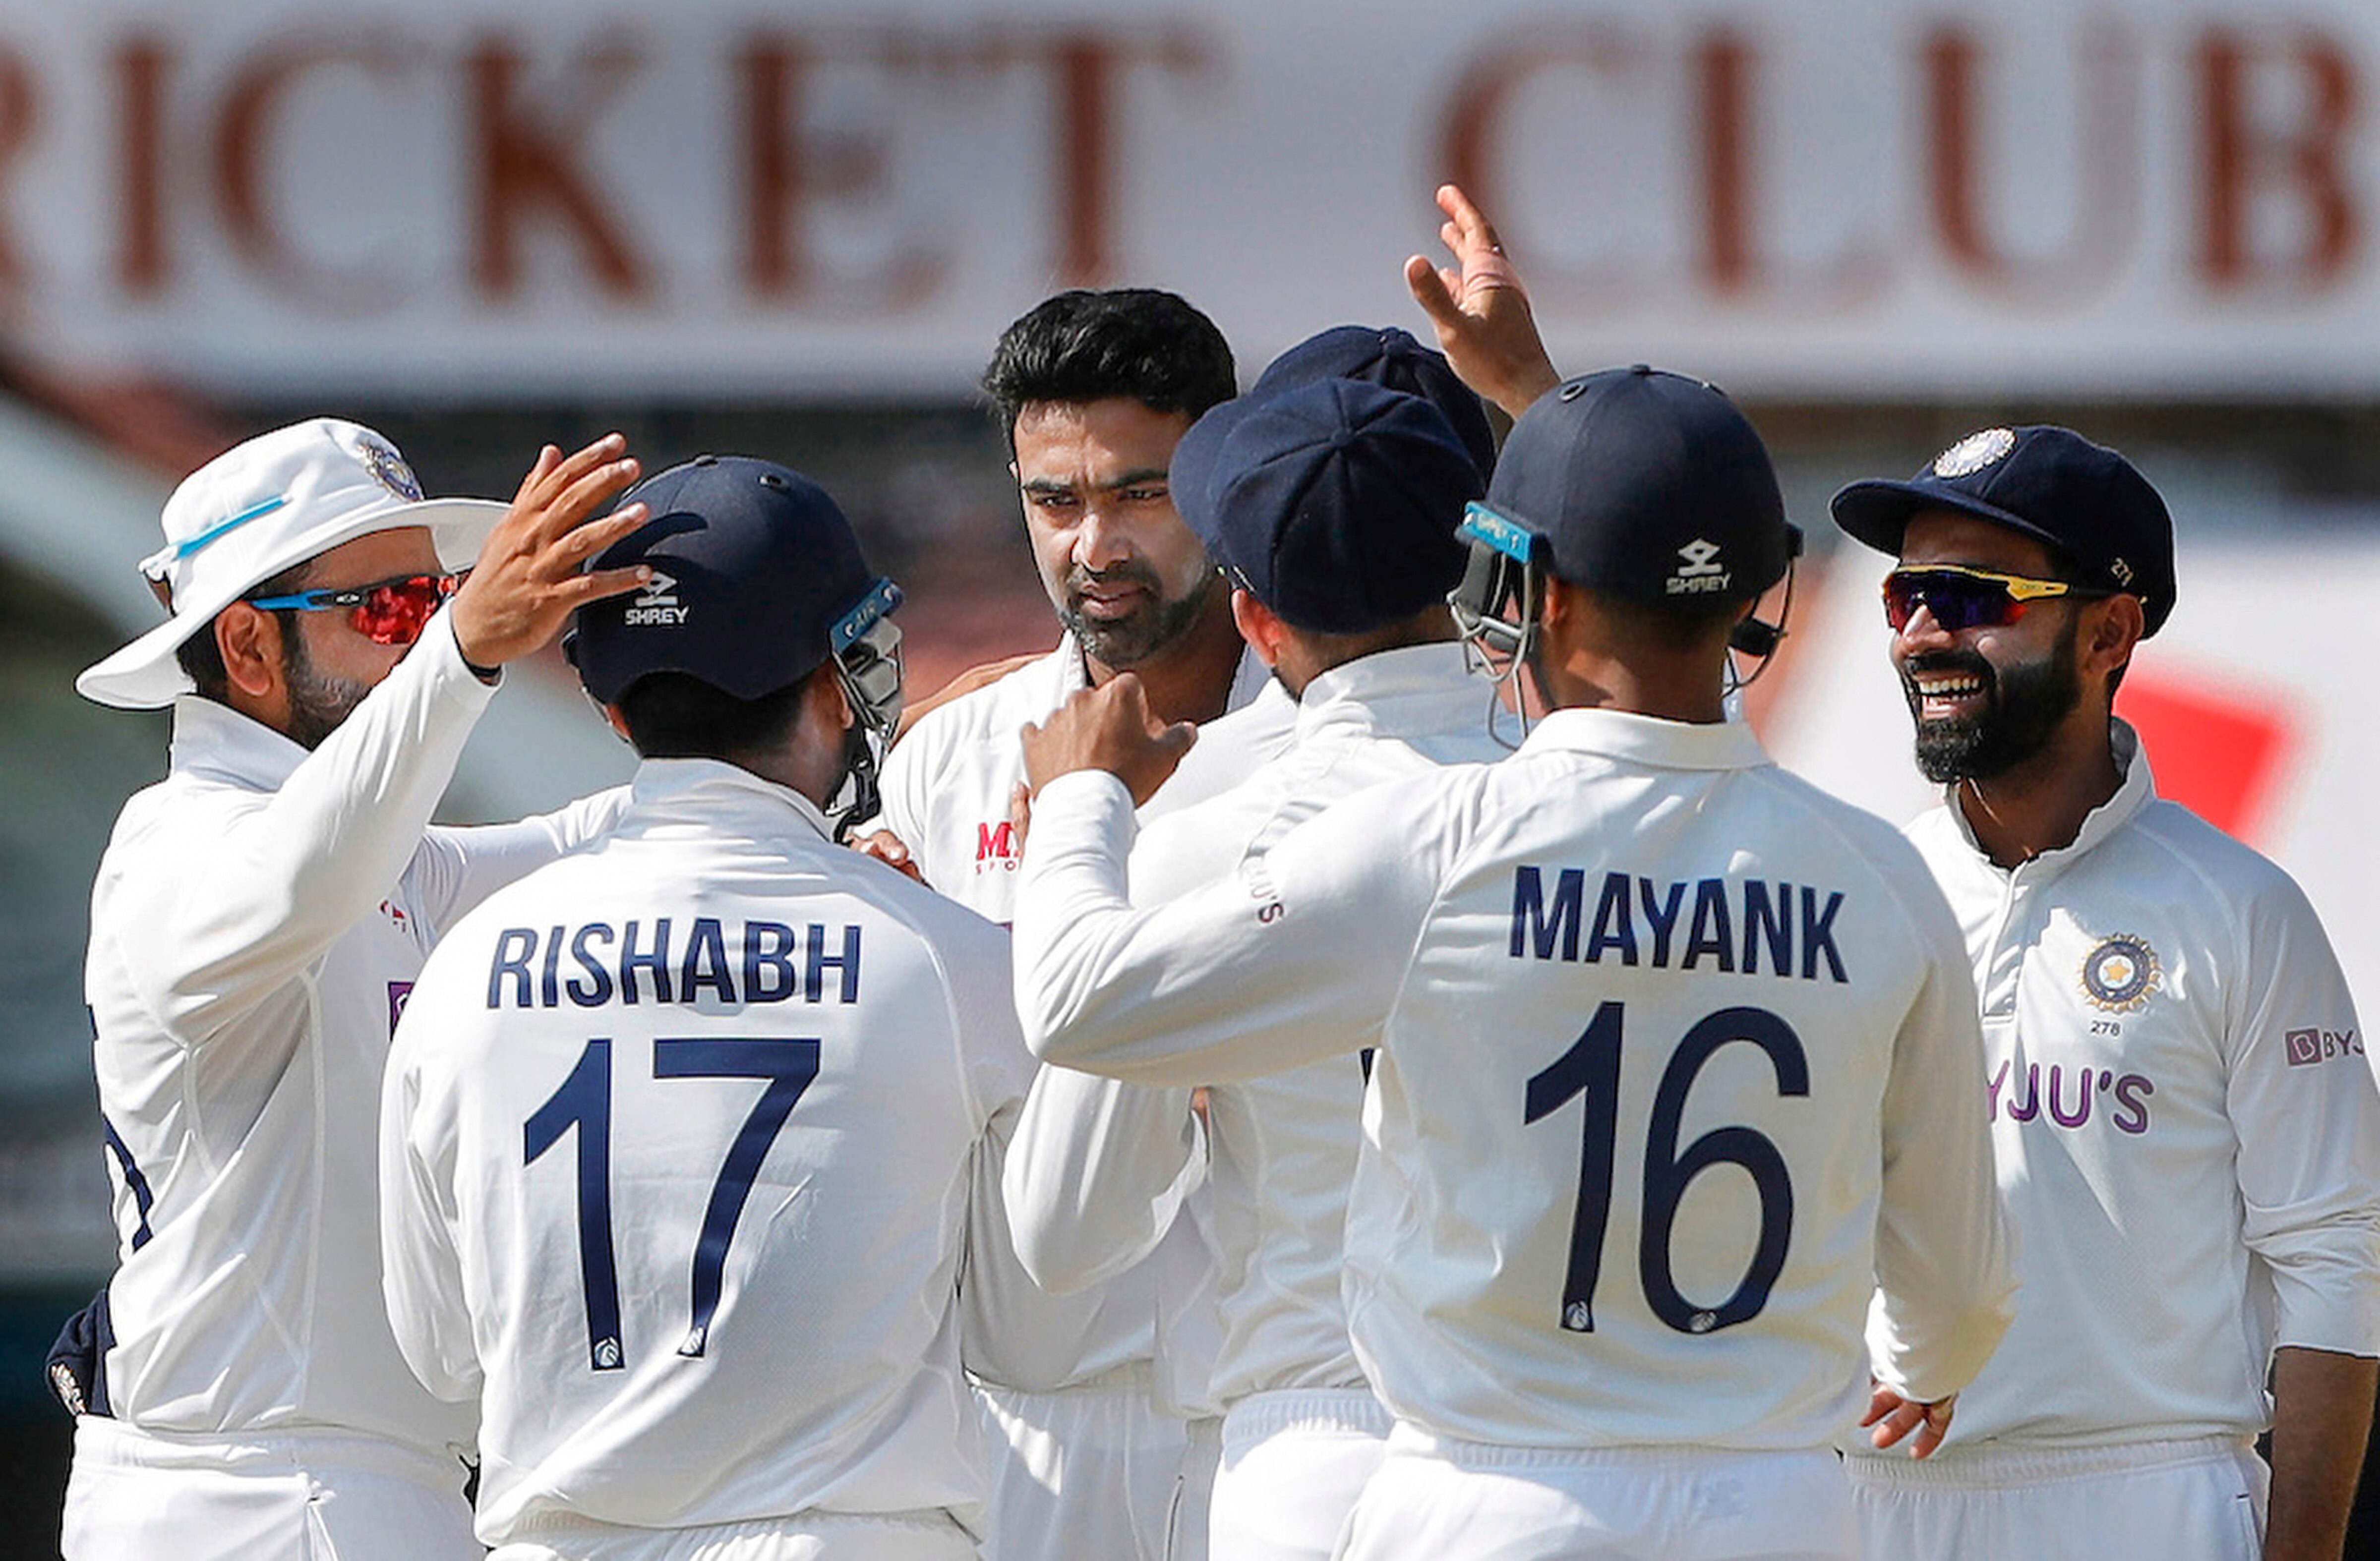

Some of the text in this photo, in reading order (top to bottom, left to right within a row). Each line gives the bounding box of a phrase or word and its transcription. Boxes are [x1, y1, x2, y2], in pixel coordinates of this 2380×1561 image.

[1411, 21, 2365, 317] CLUB
[625, 605, 689, 626] SHREY
[1666, 572, 1731, 594] SHREY
[486, 918, 862, 1009] RISHABH
[1509, 865, 1849, 983] MAYANK
[2090, 1020, 2121, 1037] 278
[524, 1039, 821, 1371] 17
[1524, 1001, 1810, 1334] 16
